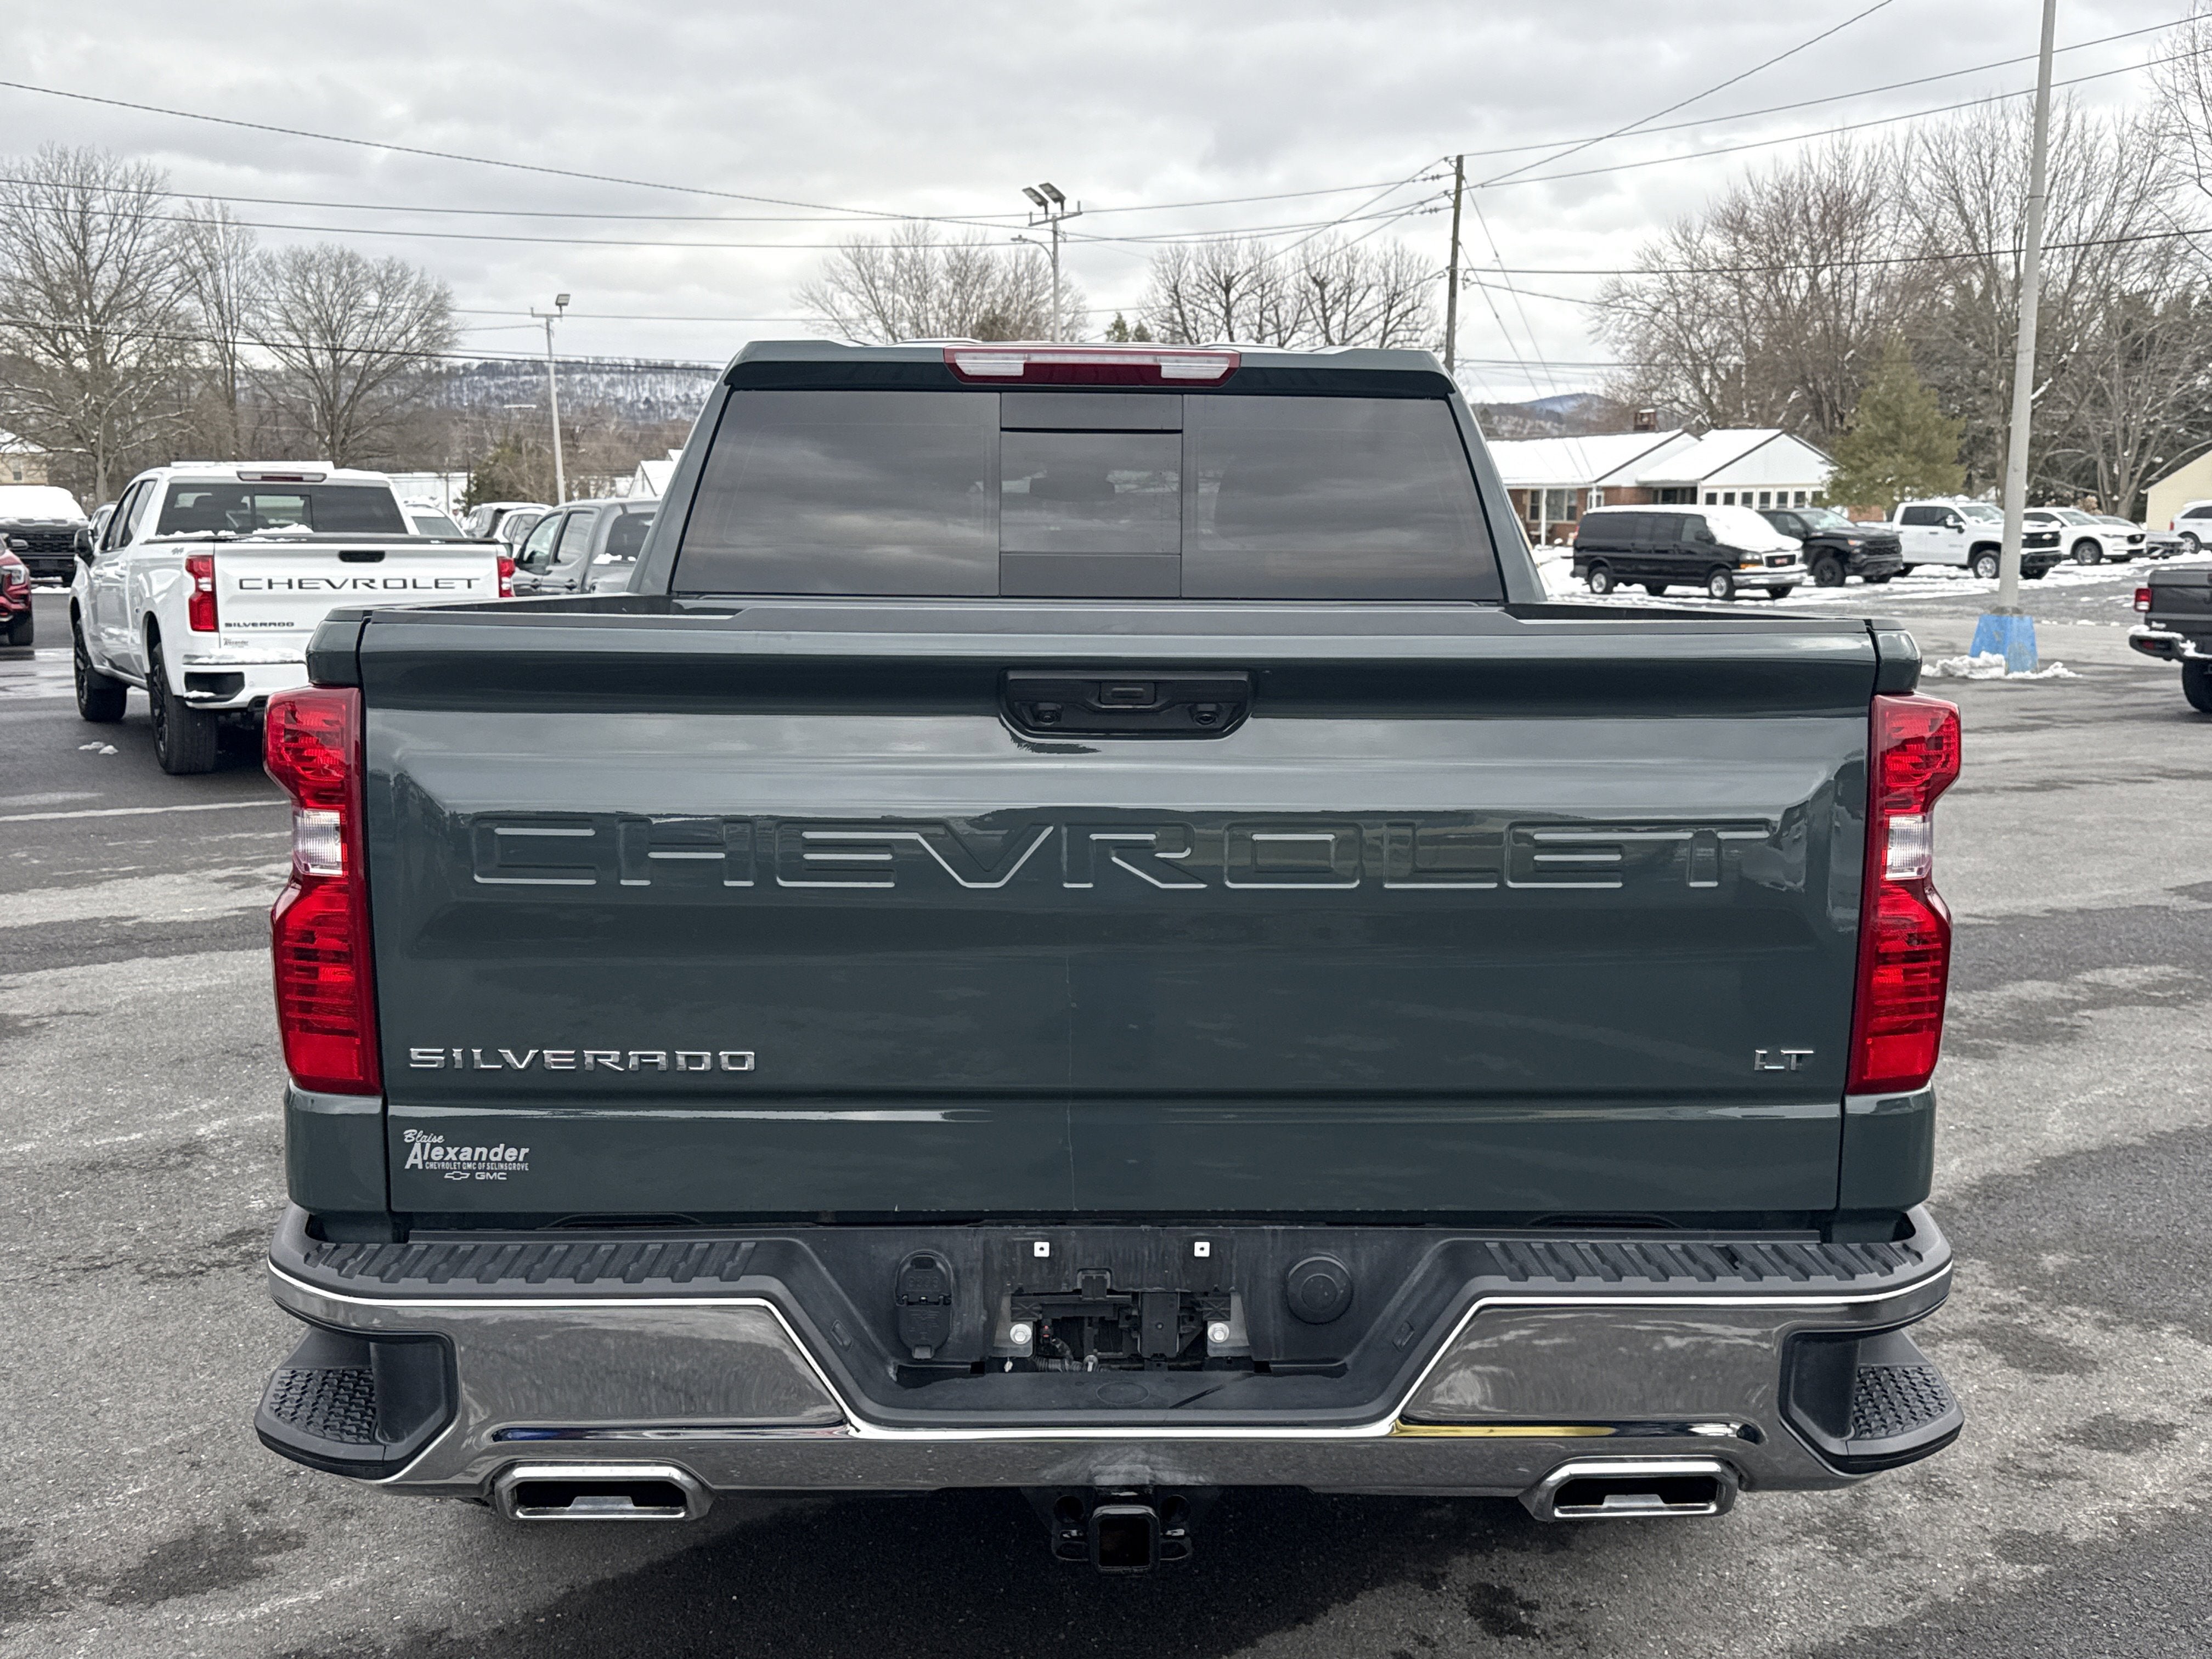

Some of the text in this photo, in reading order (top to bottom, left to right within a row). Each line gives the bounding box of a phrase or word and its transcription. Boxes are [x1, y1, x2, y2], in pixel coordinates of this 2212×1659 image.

[239, 578, 481, 590] CHEVROLET
[472, 816, 1772, 889] CHEVROLET
[409, 1047, 756, 1071] SILVERADO
[1754, 1049, 1814, 1070] LT
[403, 1129, 444, 1143] Blaise
[404, 1142, 530, 1169] Alexander
[425, 1161, 460, 1170] CHEVROLET
[475, 1172, 507, 1180] GMC
